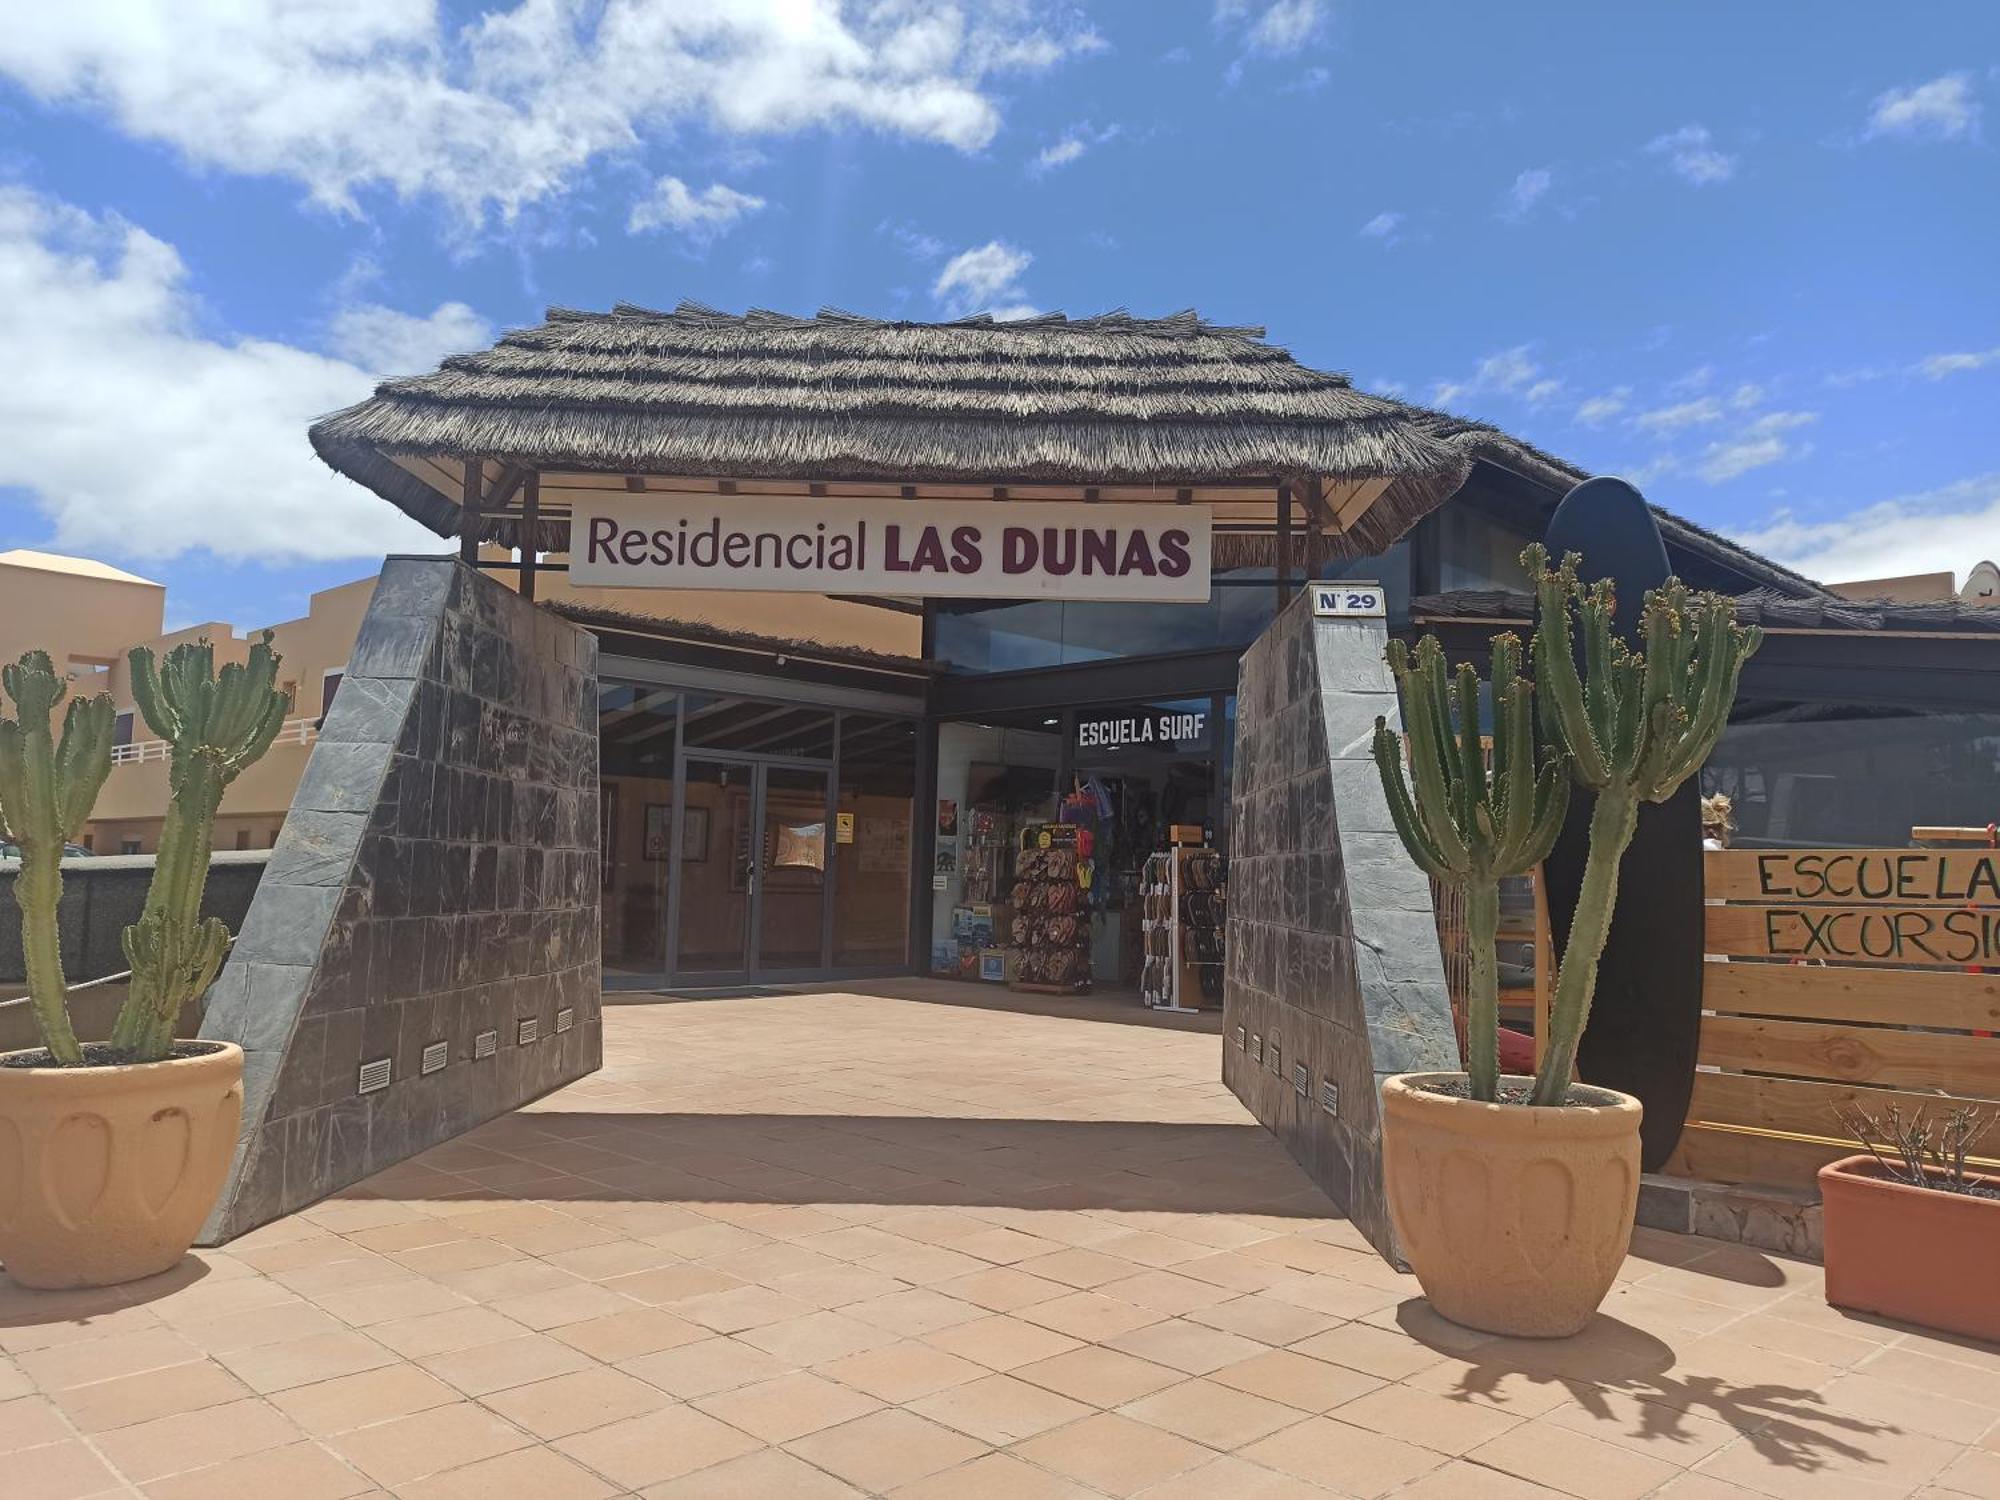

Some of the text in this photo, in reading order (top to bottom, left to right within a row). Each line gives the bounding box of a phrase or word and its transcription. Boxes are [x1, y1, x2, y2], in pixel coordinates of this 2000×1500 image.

[588, 517, 1192, 578] Residencial LAS DUNAS
[1346, 594, 1377, 609] 29
[1079, 713, 1205, 746] ESCUELA SURF
[1758, 855, 2000, 898] ESCUELA
[1766, 910, 2000, 961] EXCURSI
